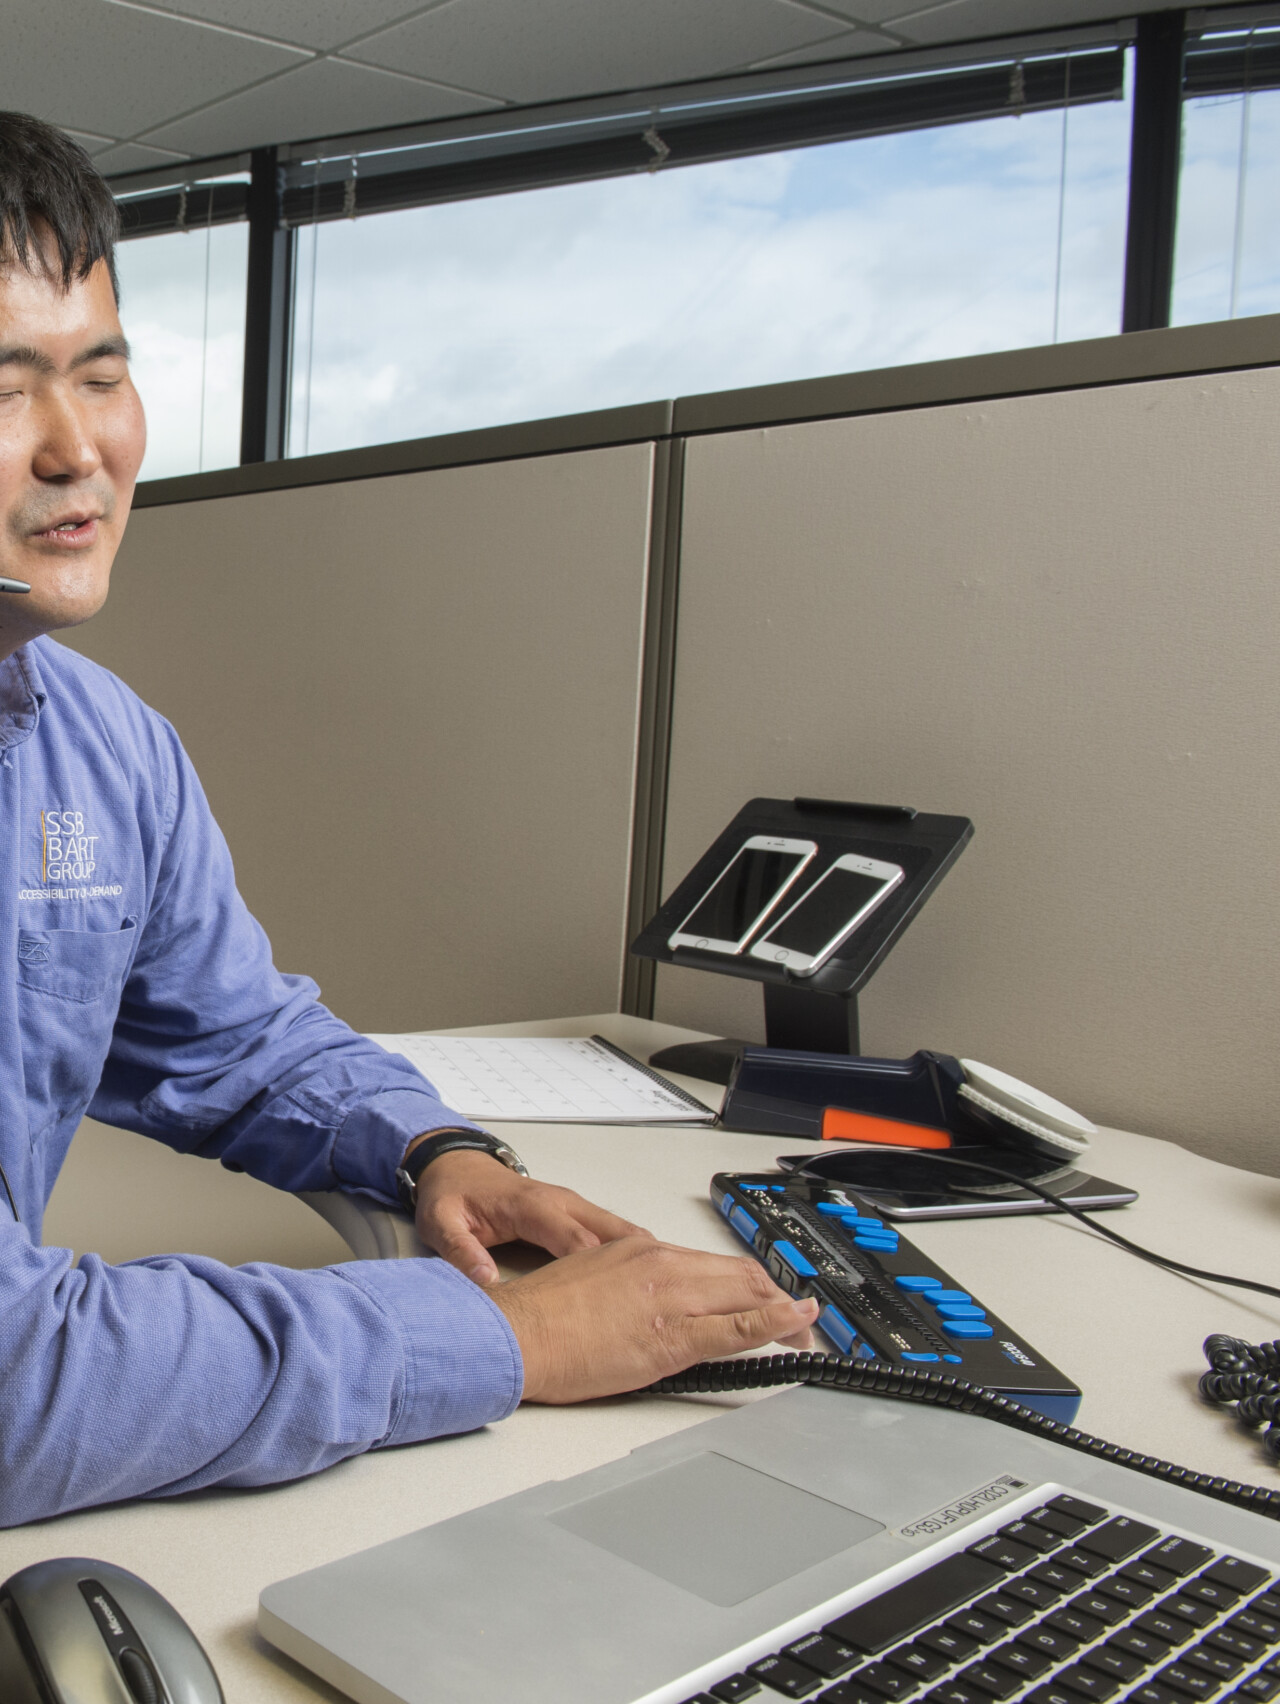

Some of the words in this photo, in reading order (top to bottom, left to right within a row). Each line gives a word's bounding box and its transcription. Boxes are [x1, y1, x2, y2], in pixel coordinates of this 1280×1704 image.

[46, 811, 84, 836] SSB
[48, 861, 96, 880] GROUP
[1047, 1570, 1063, 1580] X
[1138, 1569, 1154, 1578] A
[1022, 1586, 1037, 1595] C
[1116, 1585, 1131, 1594] S
[996, 1603, 1012, 1612] V
[1091, 1601, 1107, 1610] D
[1178, 1604, 1196, 1614] W
[94, 1595, 124, 1636] Microsoft
[968, 1620, 984, 1628] B
[1067, 1618, 1081, 1627] F
[1155, 1620, 1172, 1630] E
[790, 1634, 822, 1654] command
[938, 1636, 956, 1646] N
[1038, 1636, 1055, 1645] G
[1130, 1639, 1147, 1648] R
[906, 1654, 926, 1665] M
[1009, 1653, 1028, 1663] H
[1105, 1657, 1121, 1666] T
[756, 1658, 779, 1672] option
[1078, 1676, 1095, 1686] Y
[951, 1692, 969, 1703] K
